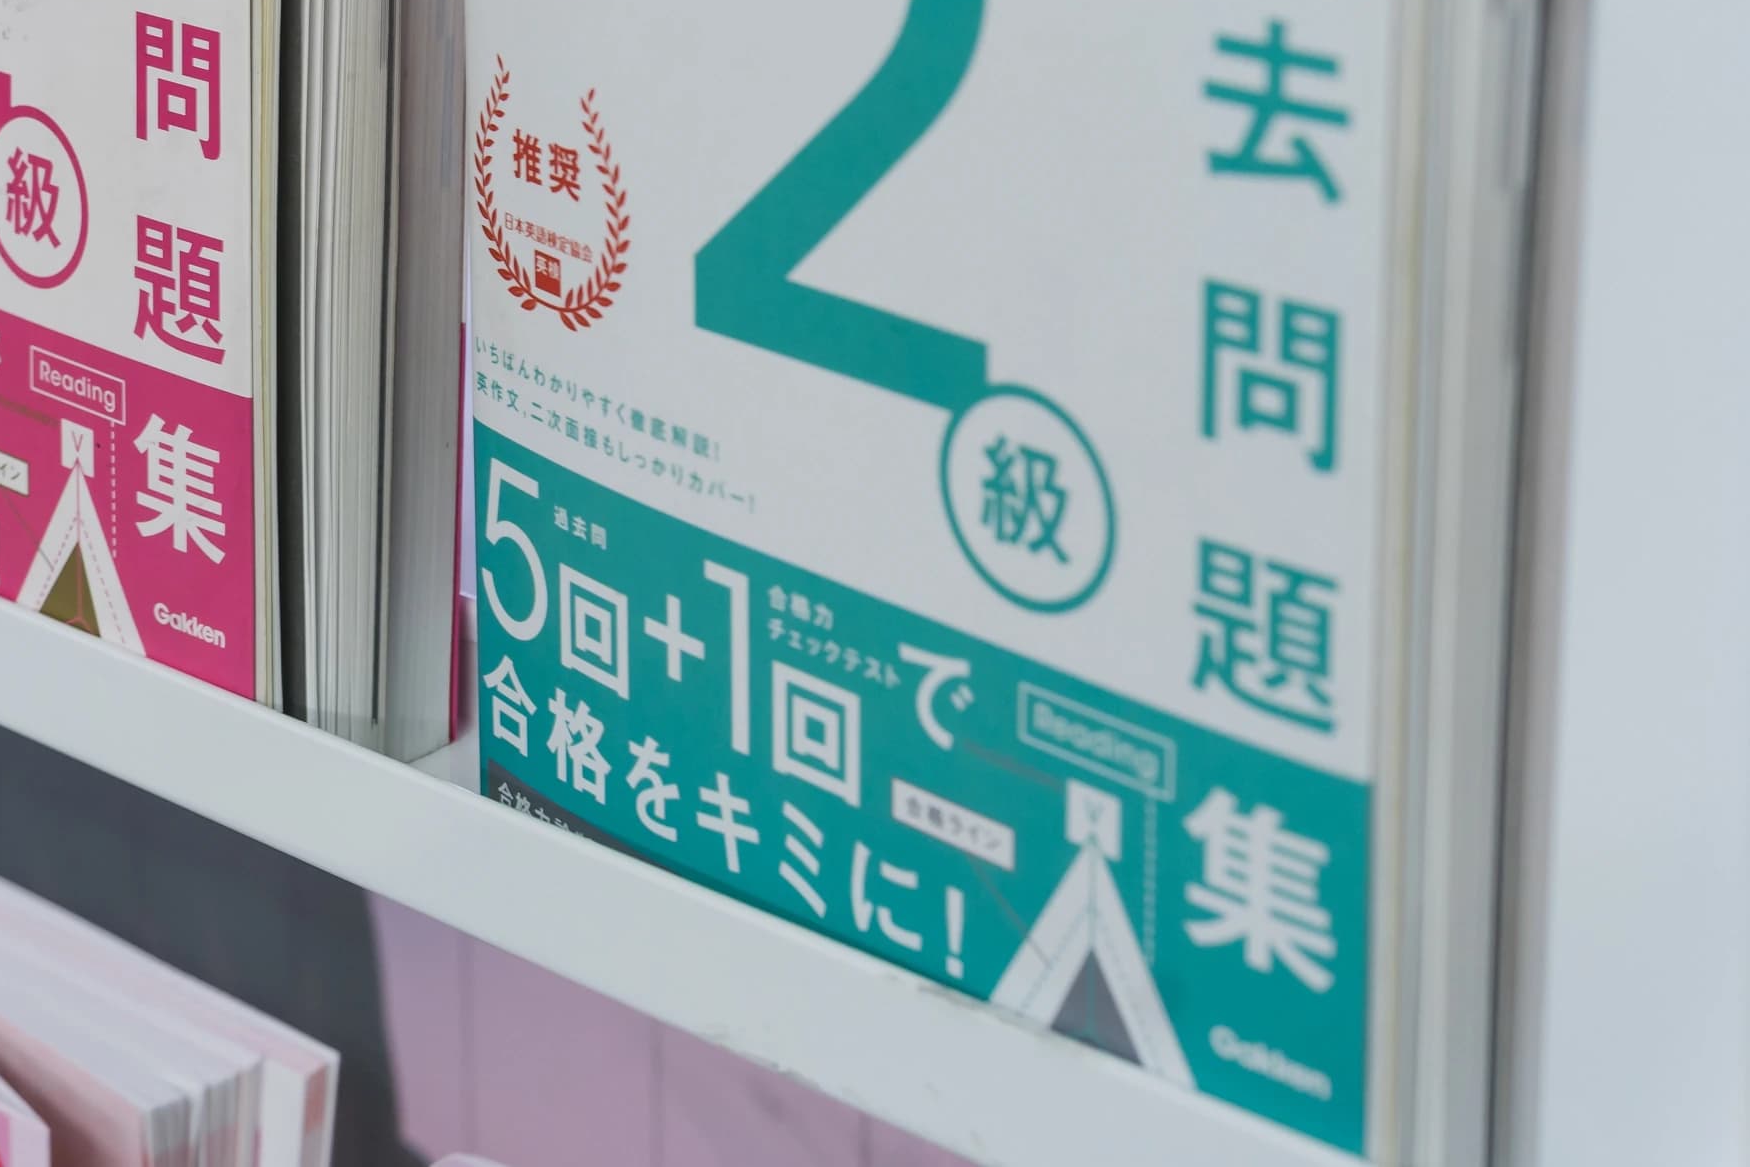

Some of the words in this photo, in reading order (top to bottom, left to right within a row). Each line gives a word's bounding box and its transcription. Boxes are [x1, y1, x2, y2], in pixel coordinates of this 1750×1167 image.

[4, 147, 62, 248] 級
[513, 128, 581, 202] 推奨
[503, 212, 593, 263] 日本英語検定協会
[39, 360, 117, 413] Reading
[553, 505, 608, 551] 過去問
[980, 433, 1072, 566] 級
[153, 602, 227, 649] Gakken
[766, 618, 902, 689] チェックテスト
[482, 655, 967, 981] 合格をキミに!
[1208, 1024, 1335, 1103] Gakken
